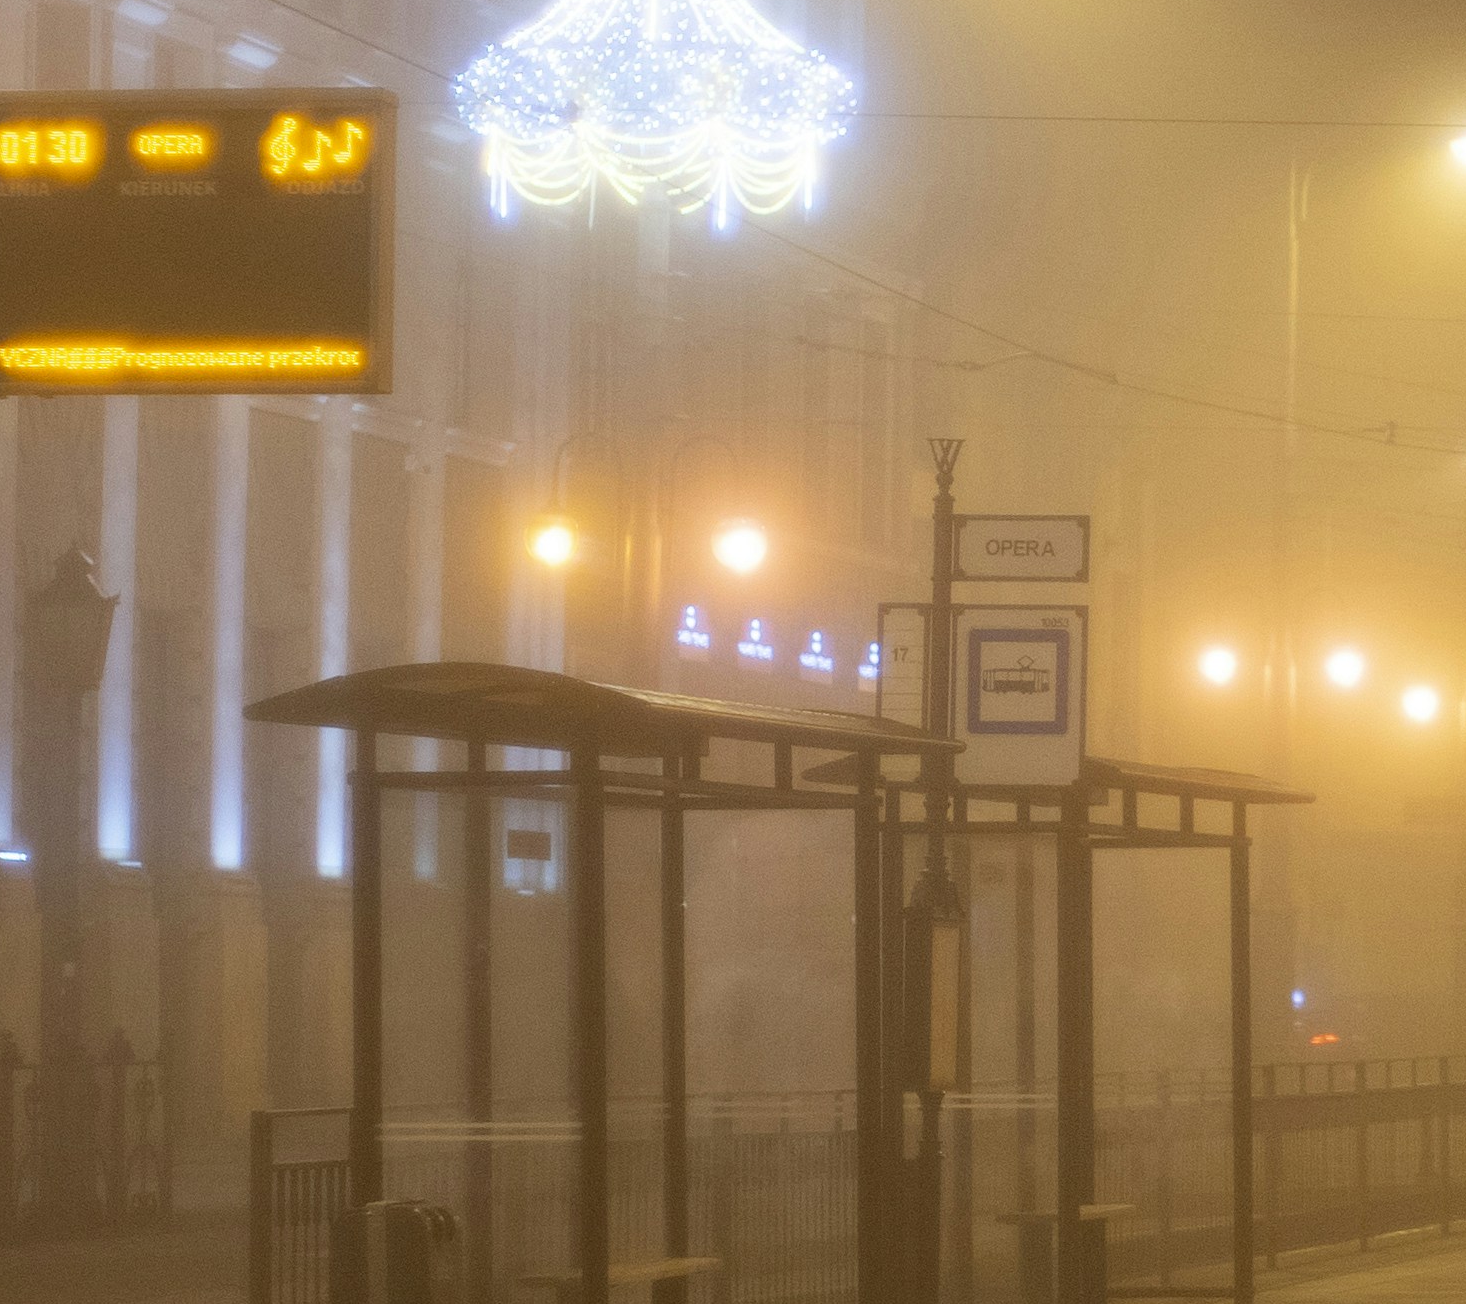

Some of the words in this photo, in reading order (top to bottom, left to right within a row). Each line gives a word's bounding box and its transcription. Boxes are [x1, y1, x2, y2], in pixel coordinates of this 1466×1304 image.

[137, 134, 203, 155] OPERA
[119, 180, 216, 197] KIERUNEK
[985, 538, 1056, 558] OPERA
[891, 647, 908, 663] 17
